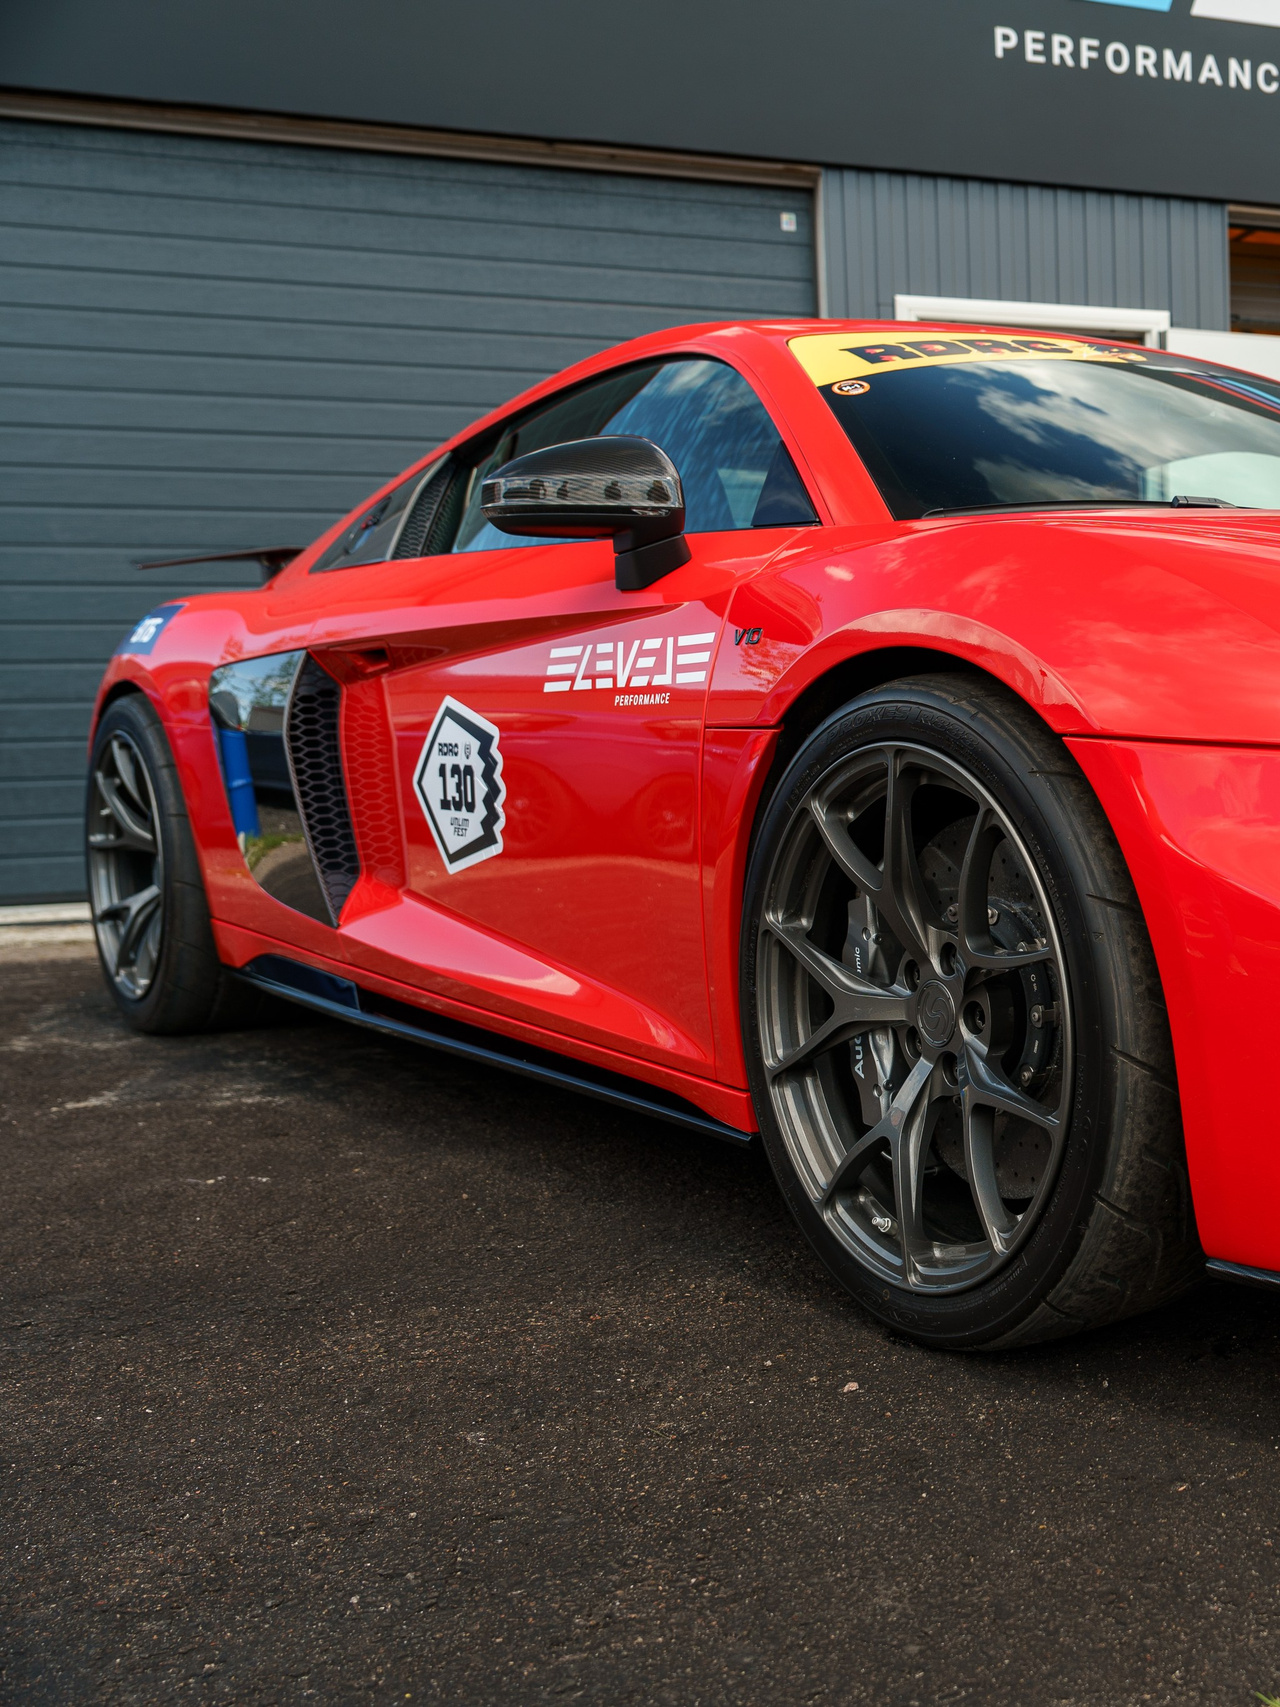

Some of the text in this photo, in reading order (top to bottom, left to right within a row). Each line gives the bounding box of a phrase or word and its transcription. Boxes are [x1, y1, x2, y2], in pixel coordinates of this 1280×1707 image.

[838, 338, 1074, 365] RDRC
[734, 627, 763, 646] V10
[614, 692, 671, 707] PERFORMANCE
[438, 763, 476, 813] 130
